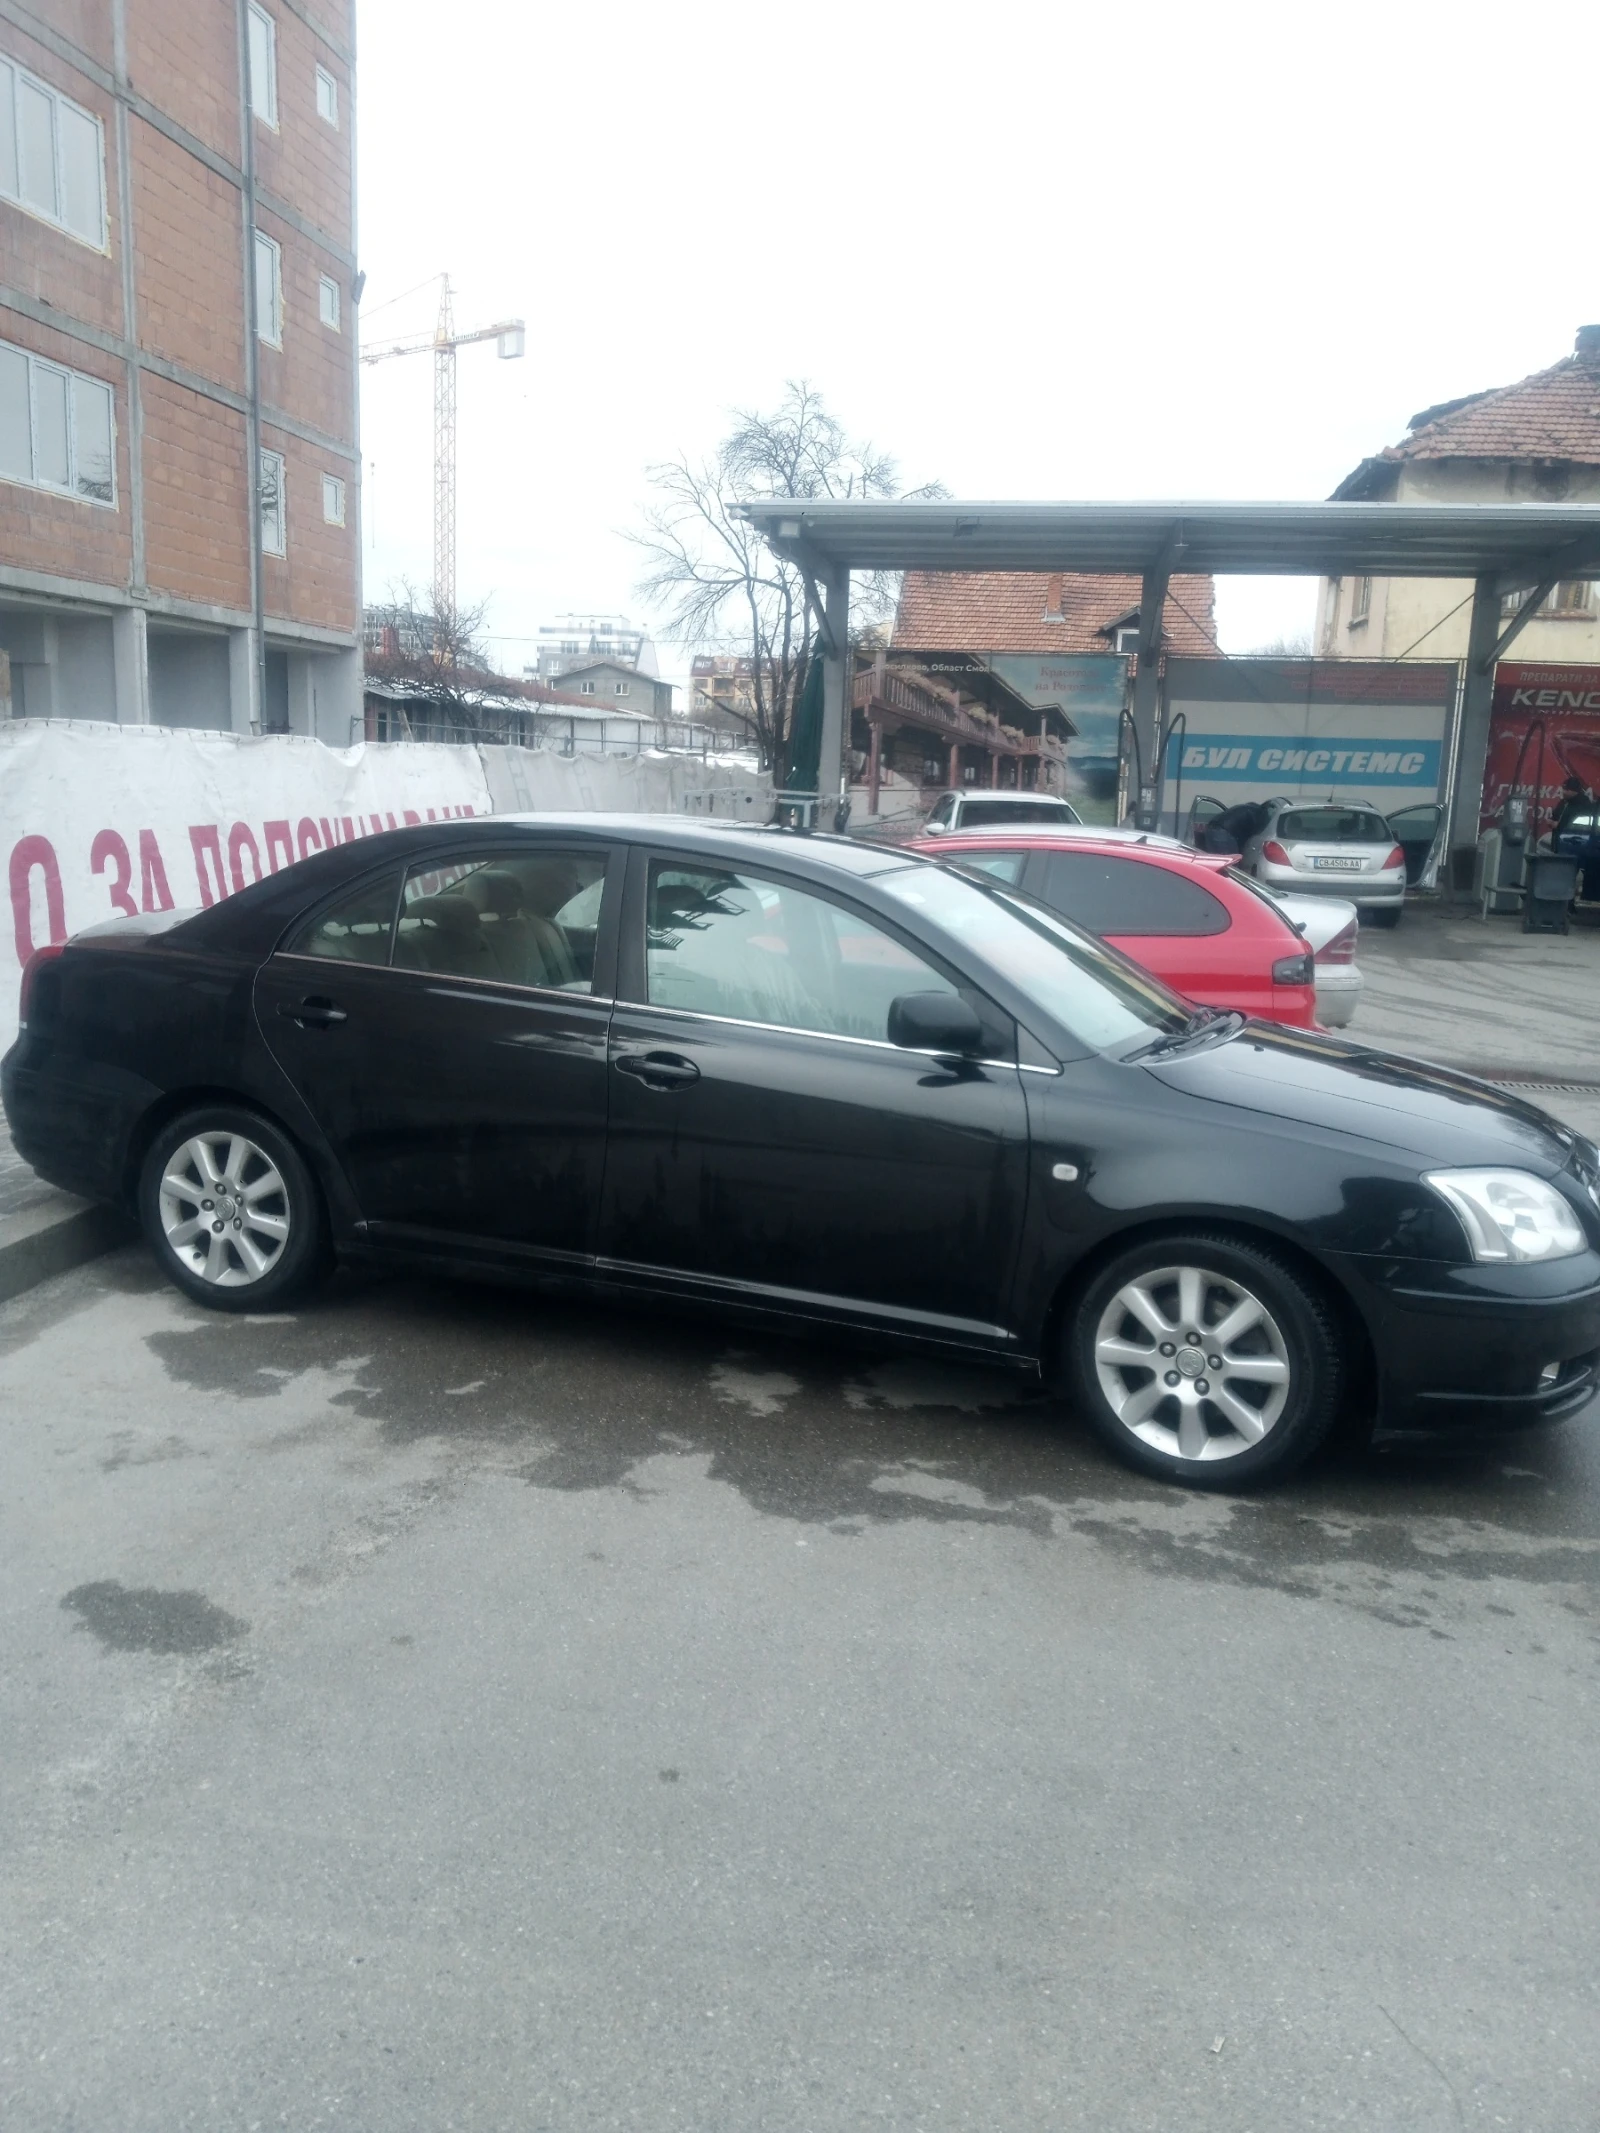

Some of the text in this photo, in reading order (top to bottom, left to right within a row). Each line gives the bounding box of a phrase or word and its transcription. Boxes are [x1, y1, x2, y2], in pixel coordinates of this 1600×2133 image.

[1520, 672, 1599, 683] ПРЕПАРАТИ ЗА
[1181, 747, 1425, 775] БУЛ СИСТЕМС
[90, 828, 175, 917] ЗА
[1330, 859, 1349, 867] 4506
